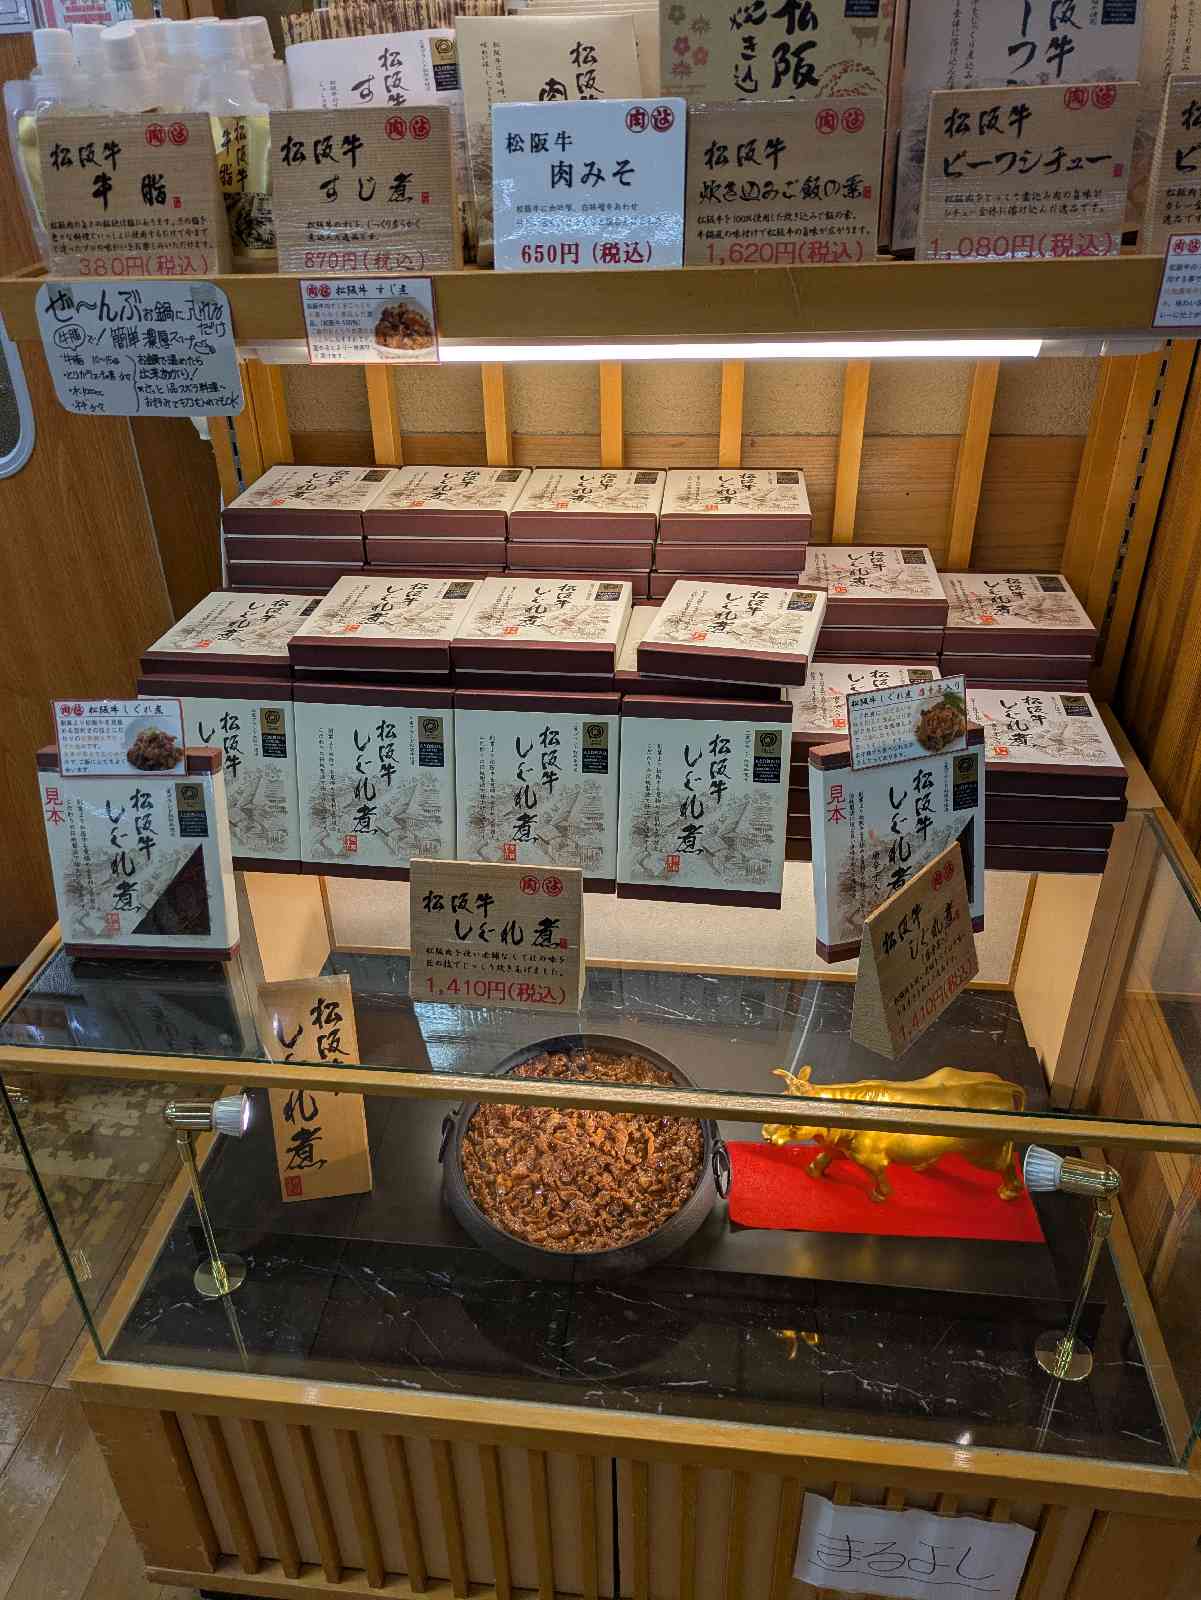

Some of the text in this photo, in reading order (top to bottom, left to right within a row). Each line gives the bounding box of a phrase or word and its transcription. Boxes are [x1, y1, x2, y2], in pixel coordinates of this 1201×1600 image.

[944, 104, 1032, 138] 松阪牛
[50, 141, 122, 171] 松阪牛
[281, 134, 364, 168] 松阪牛
[506, 131, 573, 153] 松阪牛
[704, 137, 787, 170] 松阪牛
[551, 159, 635, 189] 肉みそ
[944, 147, 1112, 178] ビーフシチュー
[319, 173, 414, 203] すじ煮
[699, 173, 864, 204] 炊き込みご飯の素
[706, 241, 864, 265] 1,620円(税込)
[930, 232, 1114, 259] 1,080円(税込)
[80, 255, 208, 276] 380円(税込)
[1024, 696, 1047, 725] 松阪牛
[220, 711, 245, 777] 松阪牛
[376, 720, 400, 786] 松阪牛
[539, 726, 562, 794] 松阪牛
[353, 729, 378, 835] しぐれ煮
[709, 734, 732, 804] 松阪牛
[45, 787, 64, 826] 見本
[513, 737, 538, 843] しぐれ煮
[677, 745, 704, 855] しぐれ煮
[827, 785, 847, 824] 見本
[913, 769, 936, 840] 松阪牛
[130, 788, 158, 860] 松阪牛
[104, 800, 142, 911] しぐれ煮
[423, 890, 495, 918] 松阪牛
[455, 917, 561, 949] しぐれ煮
[426, 976, 566, 1005] 1,410円(税込)
[273, 1012, 327, 1171] しれ煮
[816, 1534, 996, 1581] まるよし
